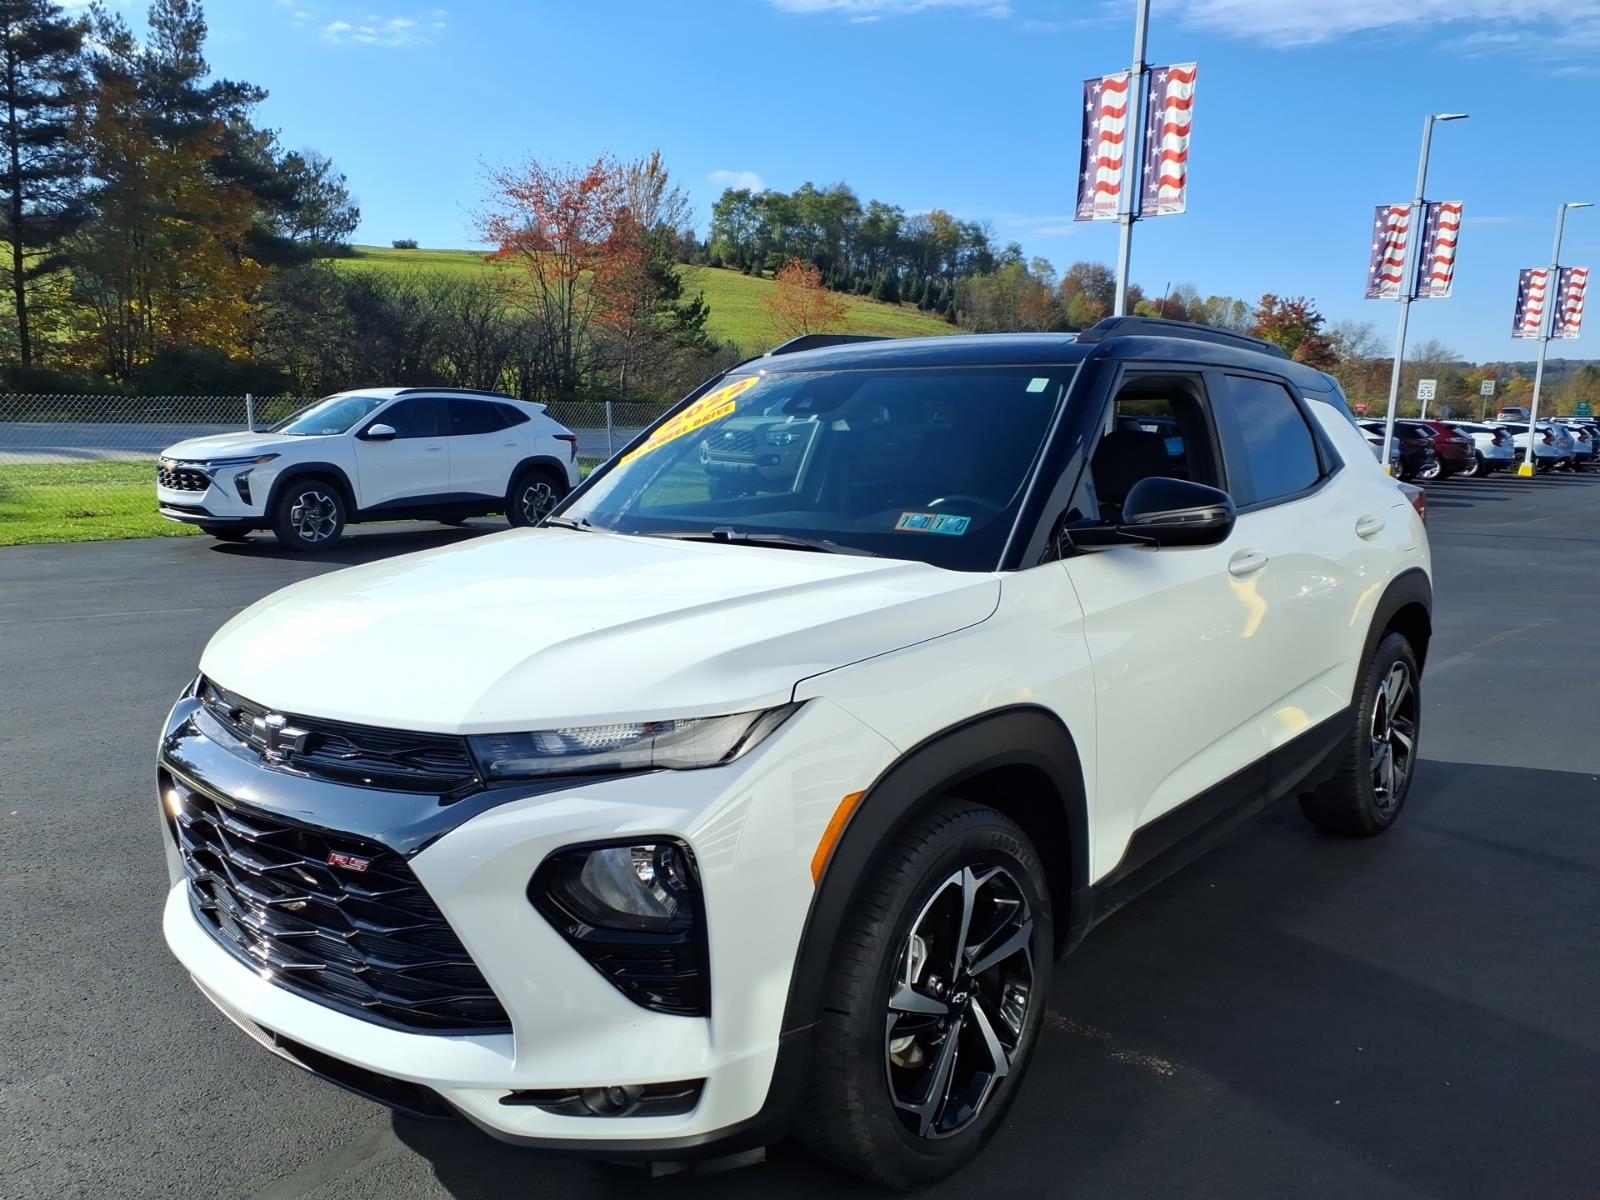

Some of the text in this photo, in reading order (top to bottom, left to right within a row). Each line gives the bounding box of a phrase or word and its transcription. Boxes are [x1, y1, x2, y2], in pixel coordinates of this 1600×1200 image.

[1420, 389, 1433, 397] 55
[665, 381, 748, 430] 2022
[693, 404, 731, 427] DRIVE
[328, 853, 370, 872] RS
